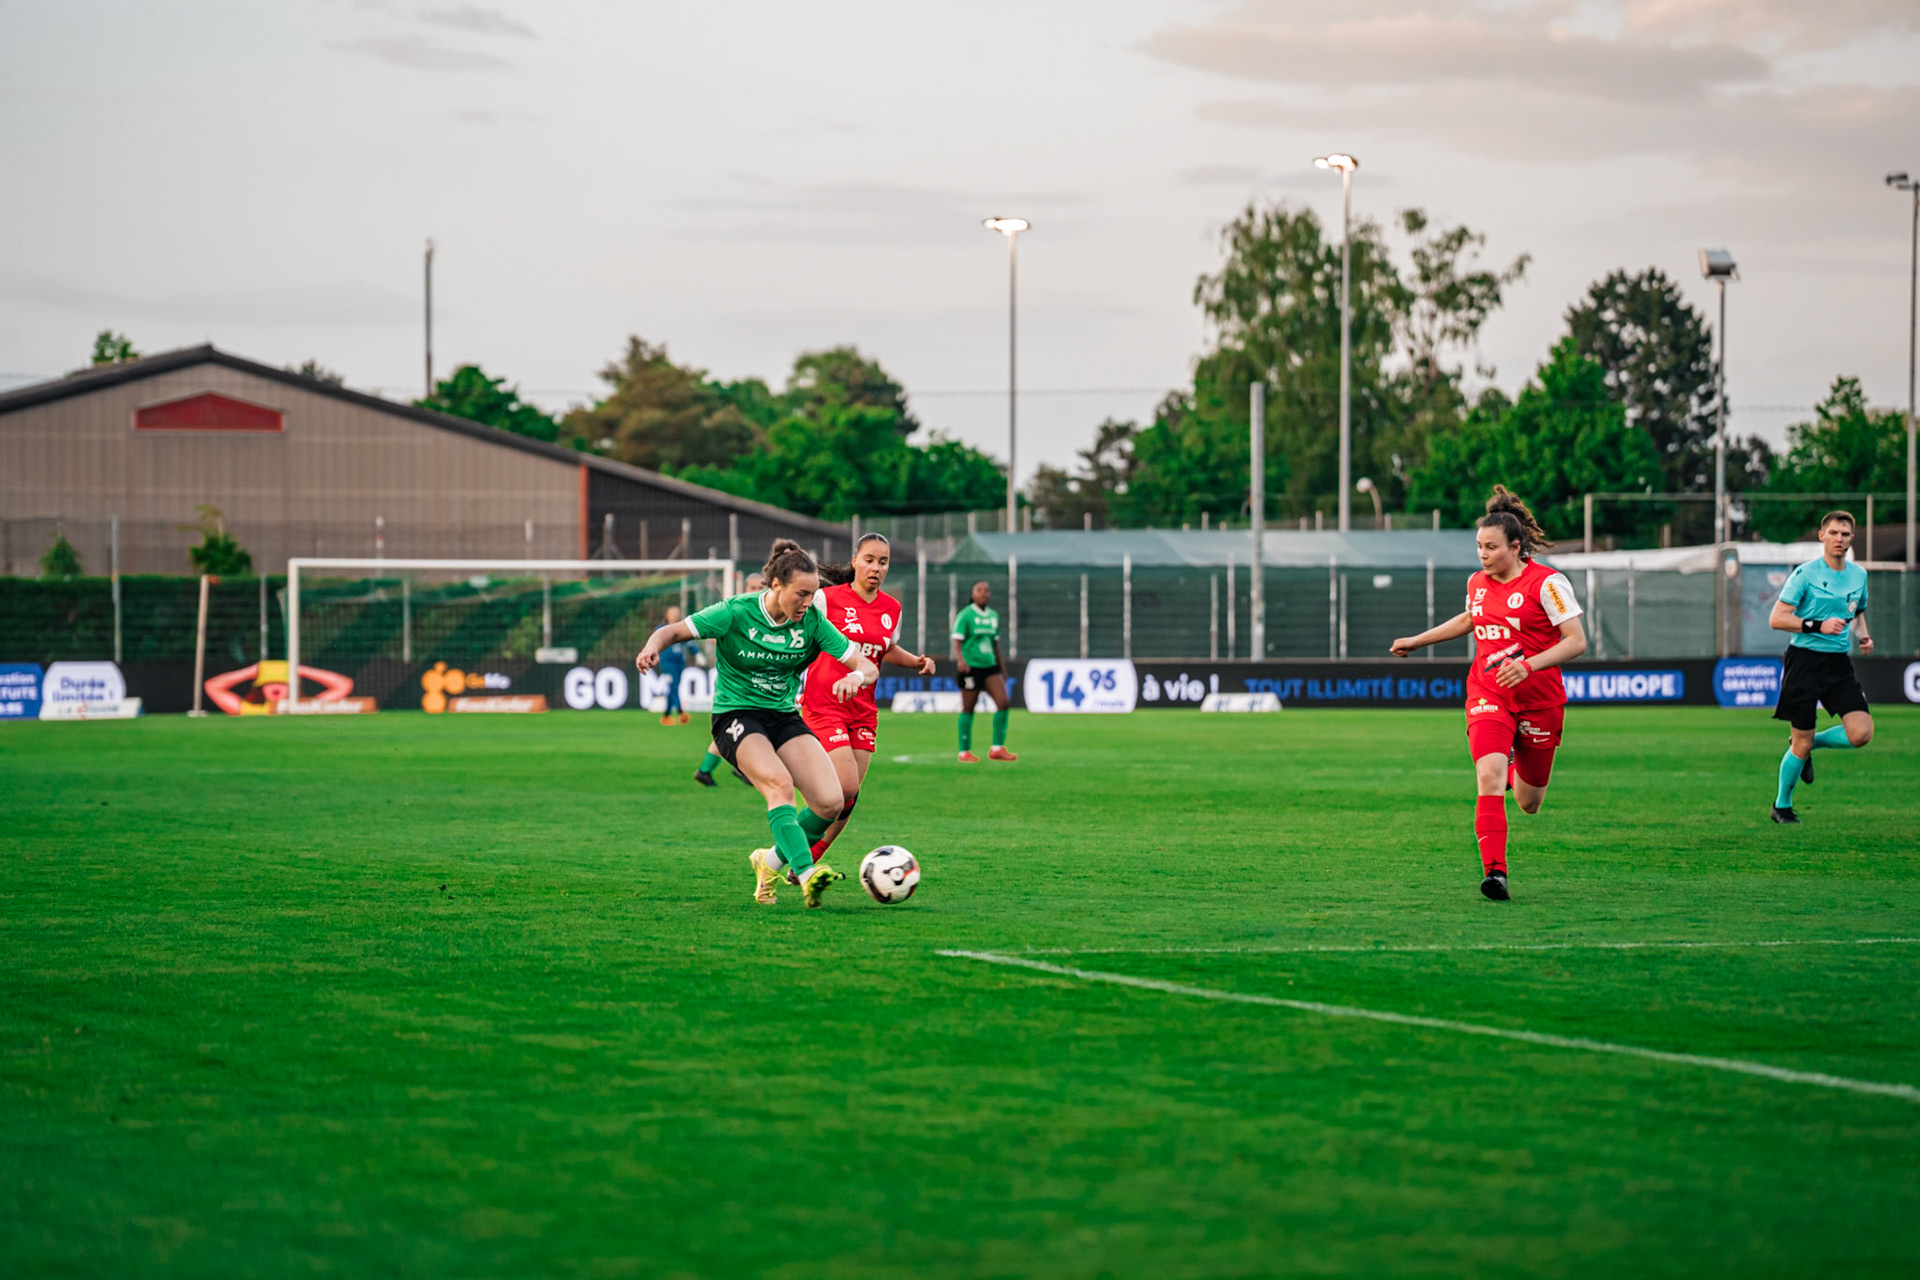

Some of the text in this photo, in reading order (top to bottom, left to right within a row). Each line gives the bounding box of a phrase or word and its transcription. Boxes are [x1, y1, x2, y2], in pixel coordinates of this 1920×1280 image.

[564, 666, 628, 710] GO
[1142, 673, 1160, 701] à
[1163, 673, 1205, 701] vie
[1244, 678, 1303, 699] TOUT
[1307, 675, 1393, 698] ILLIMITÉ
[1397, 678, 1426, 698] EN
[1588, 674, 1675, 697] EUROPE
